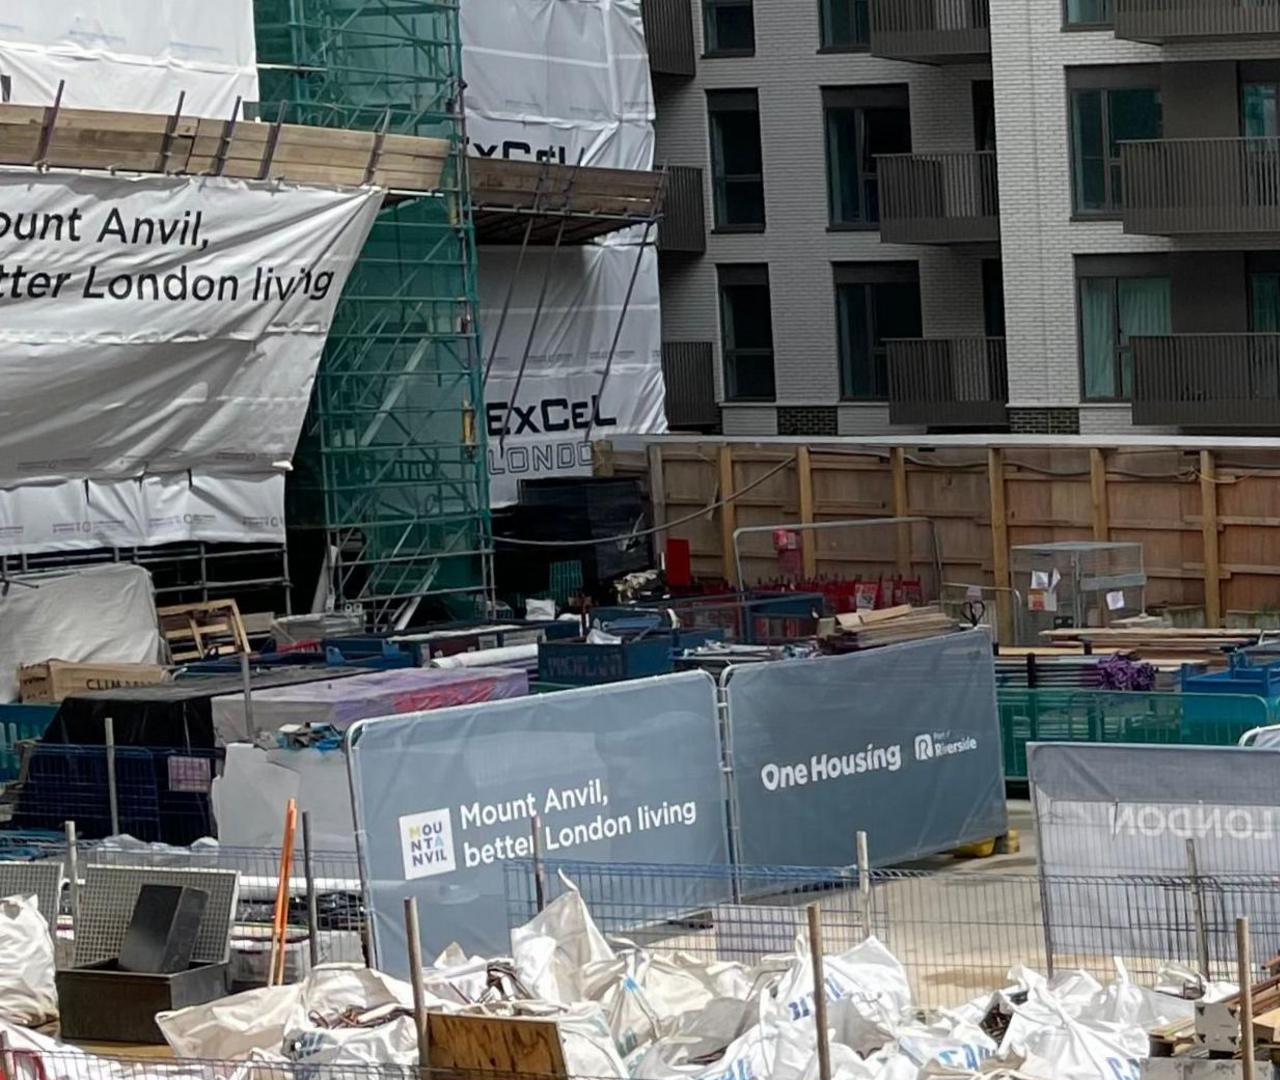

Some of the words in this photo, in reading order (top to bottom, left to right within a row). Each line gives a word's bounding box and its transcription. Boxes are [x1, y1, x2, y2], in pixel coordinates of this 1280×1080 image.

[97, 207, 209, 251] Anvil,
[82, 265, 239, 300] London
[252, 266, 335, 300] living
[487, 395, 617, 436] ExCeL
[761, 763, 808, 791] One
[811, 743, 901, 781] Housing
[934, 735, 978, 757] Riverside
[459, 793, 537, 830] Mount
[544, 778, 609, 814] Anvil,
[545, 813, 632, 850] London
[637, 800, 697, 831] living
